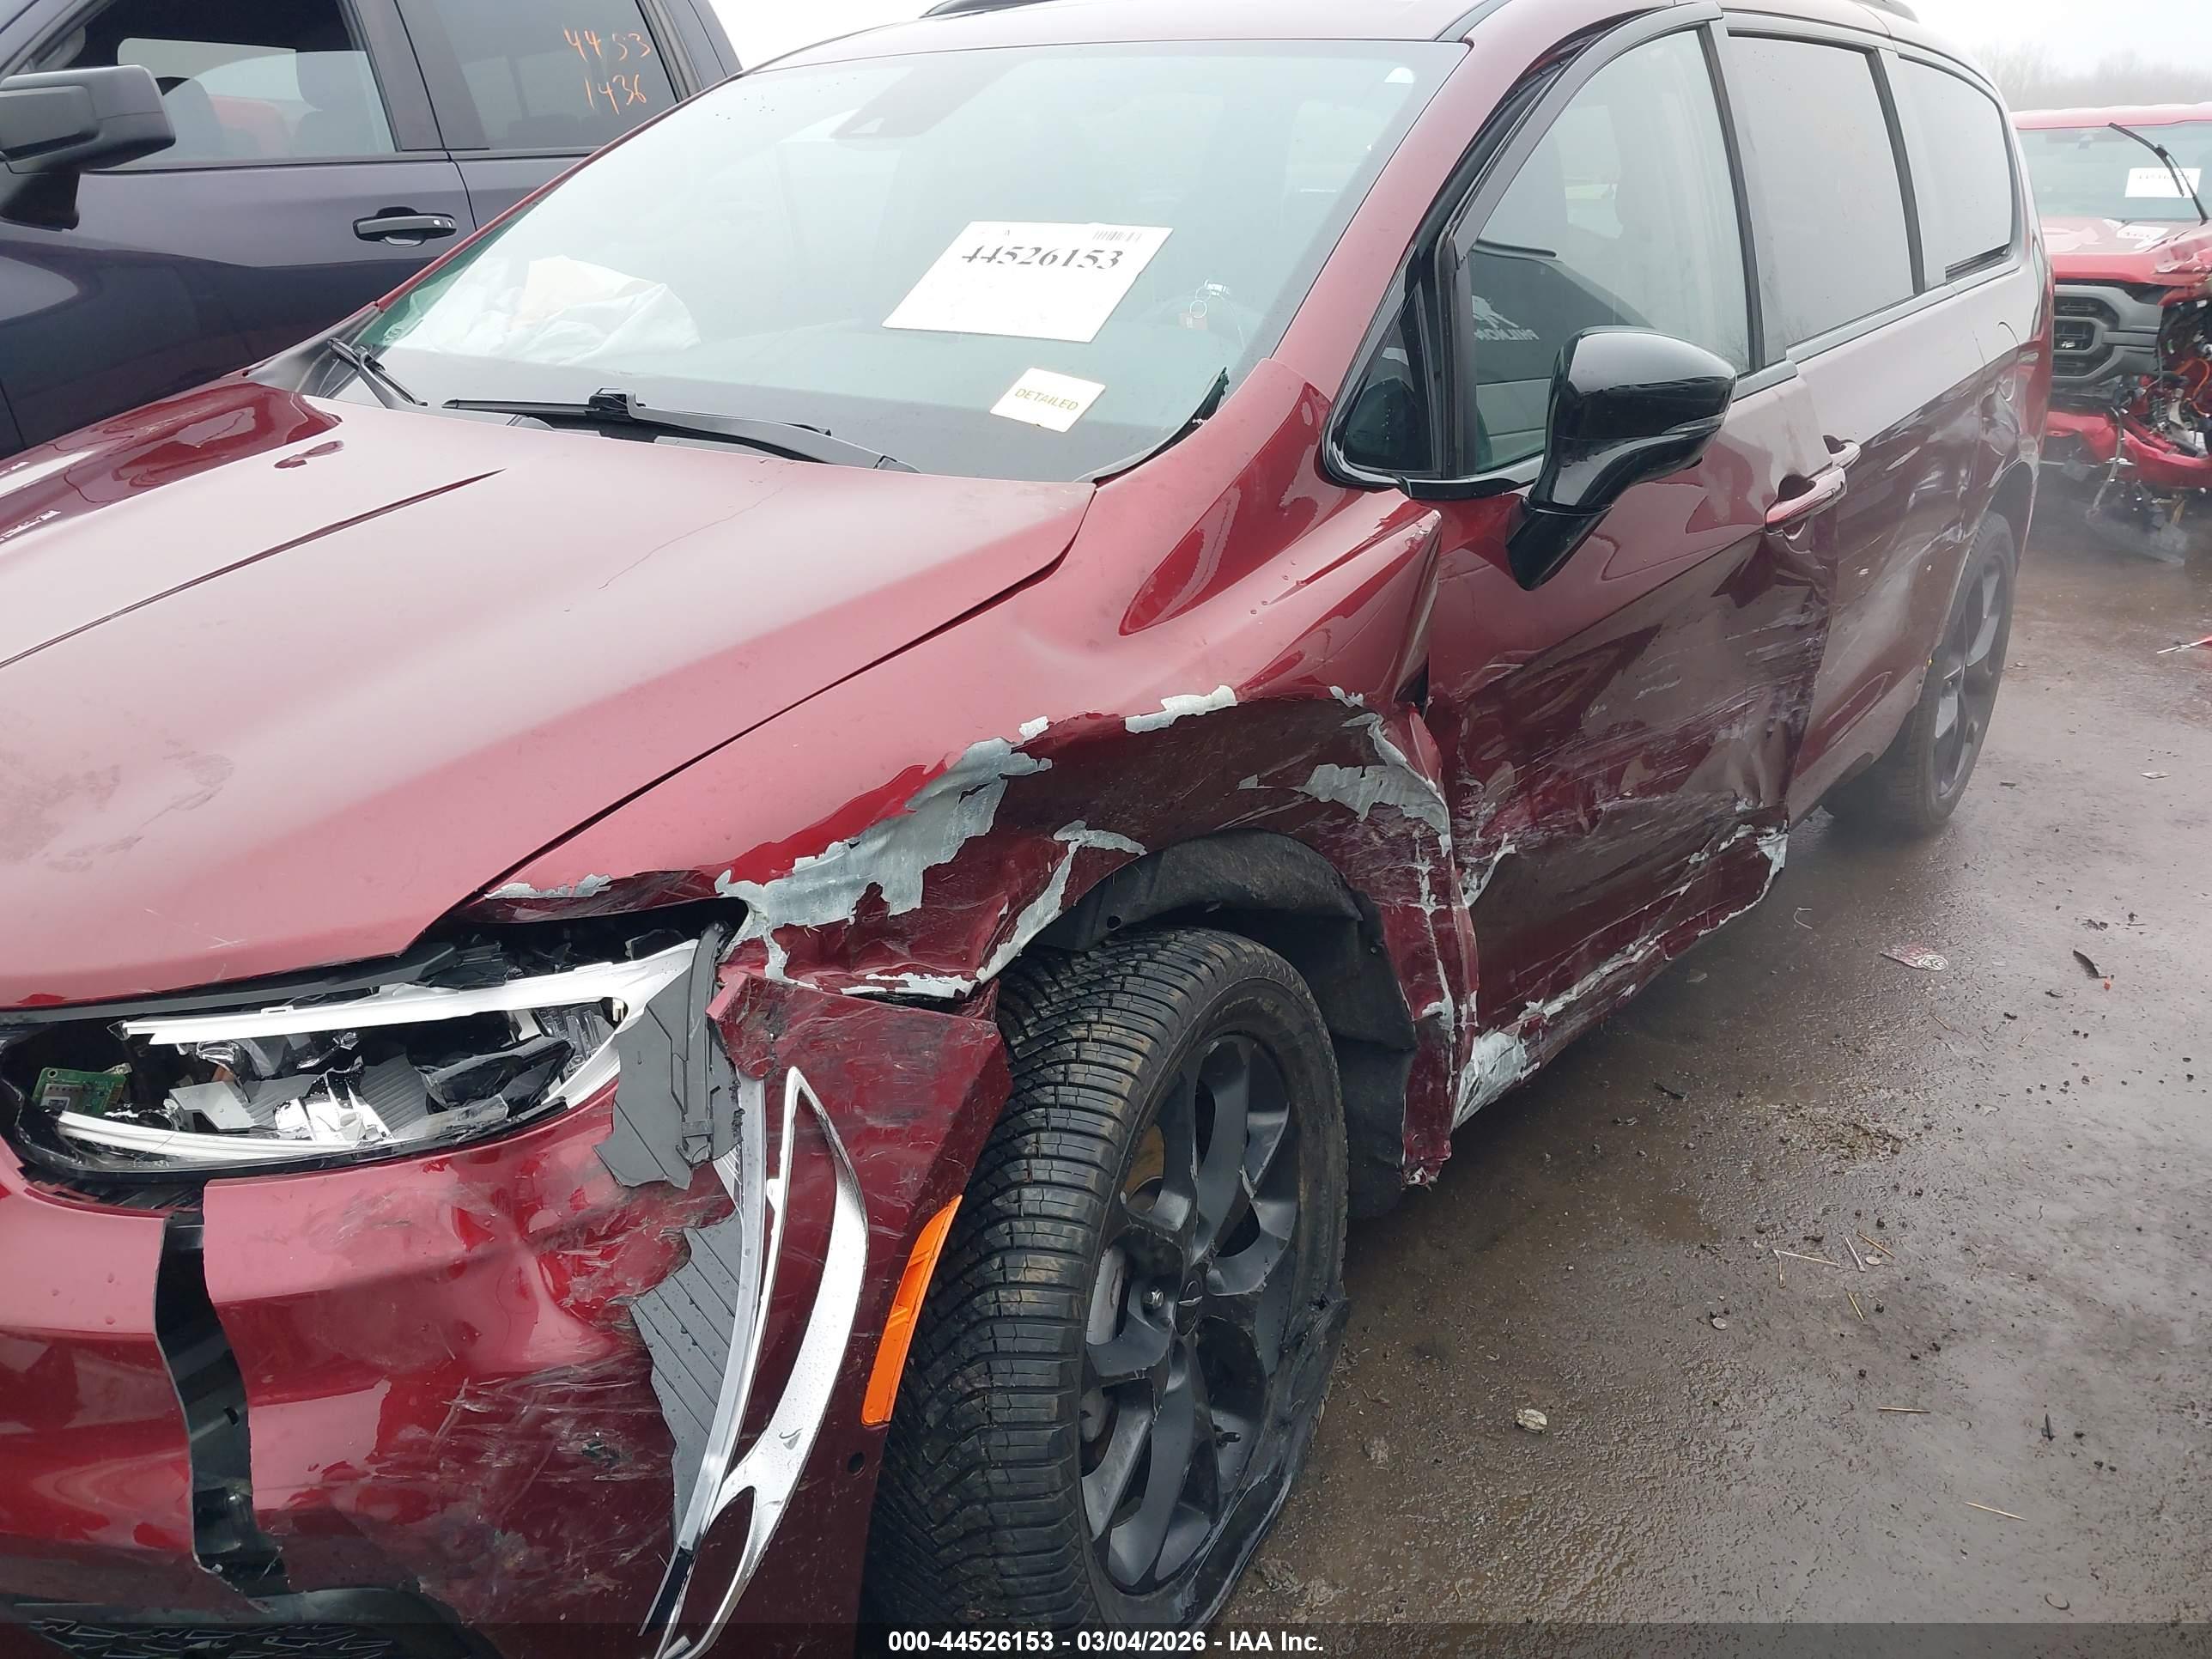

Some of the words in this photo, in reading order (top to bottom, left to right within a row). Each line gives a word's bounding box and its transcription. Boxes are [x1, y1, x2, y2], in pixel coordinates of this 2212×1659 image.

[585, 74, 647, 116] 1436
[962, 246, 1124, 270] 44526153
[1014, 388, 1079, 411] DETAILED
